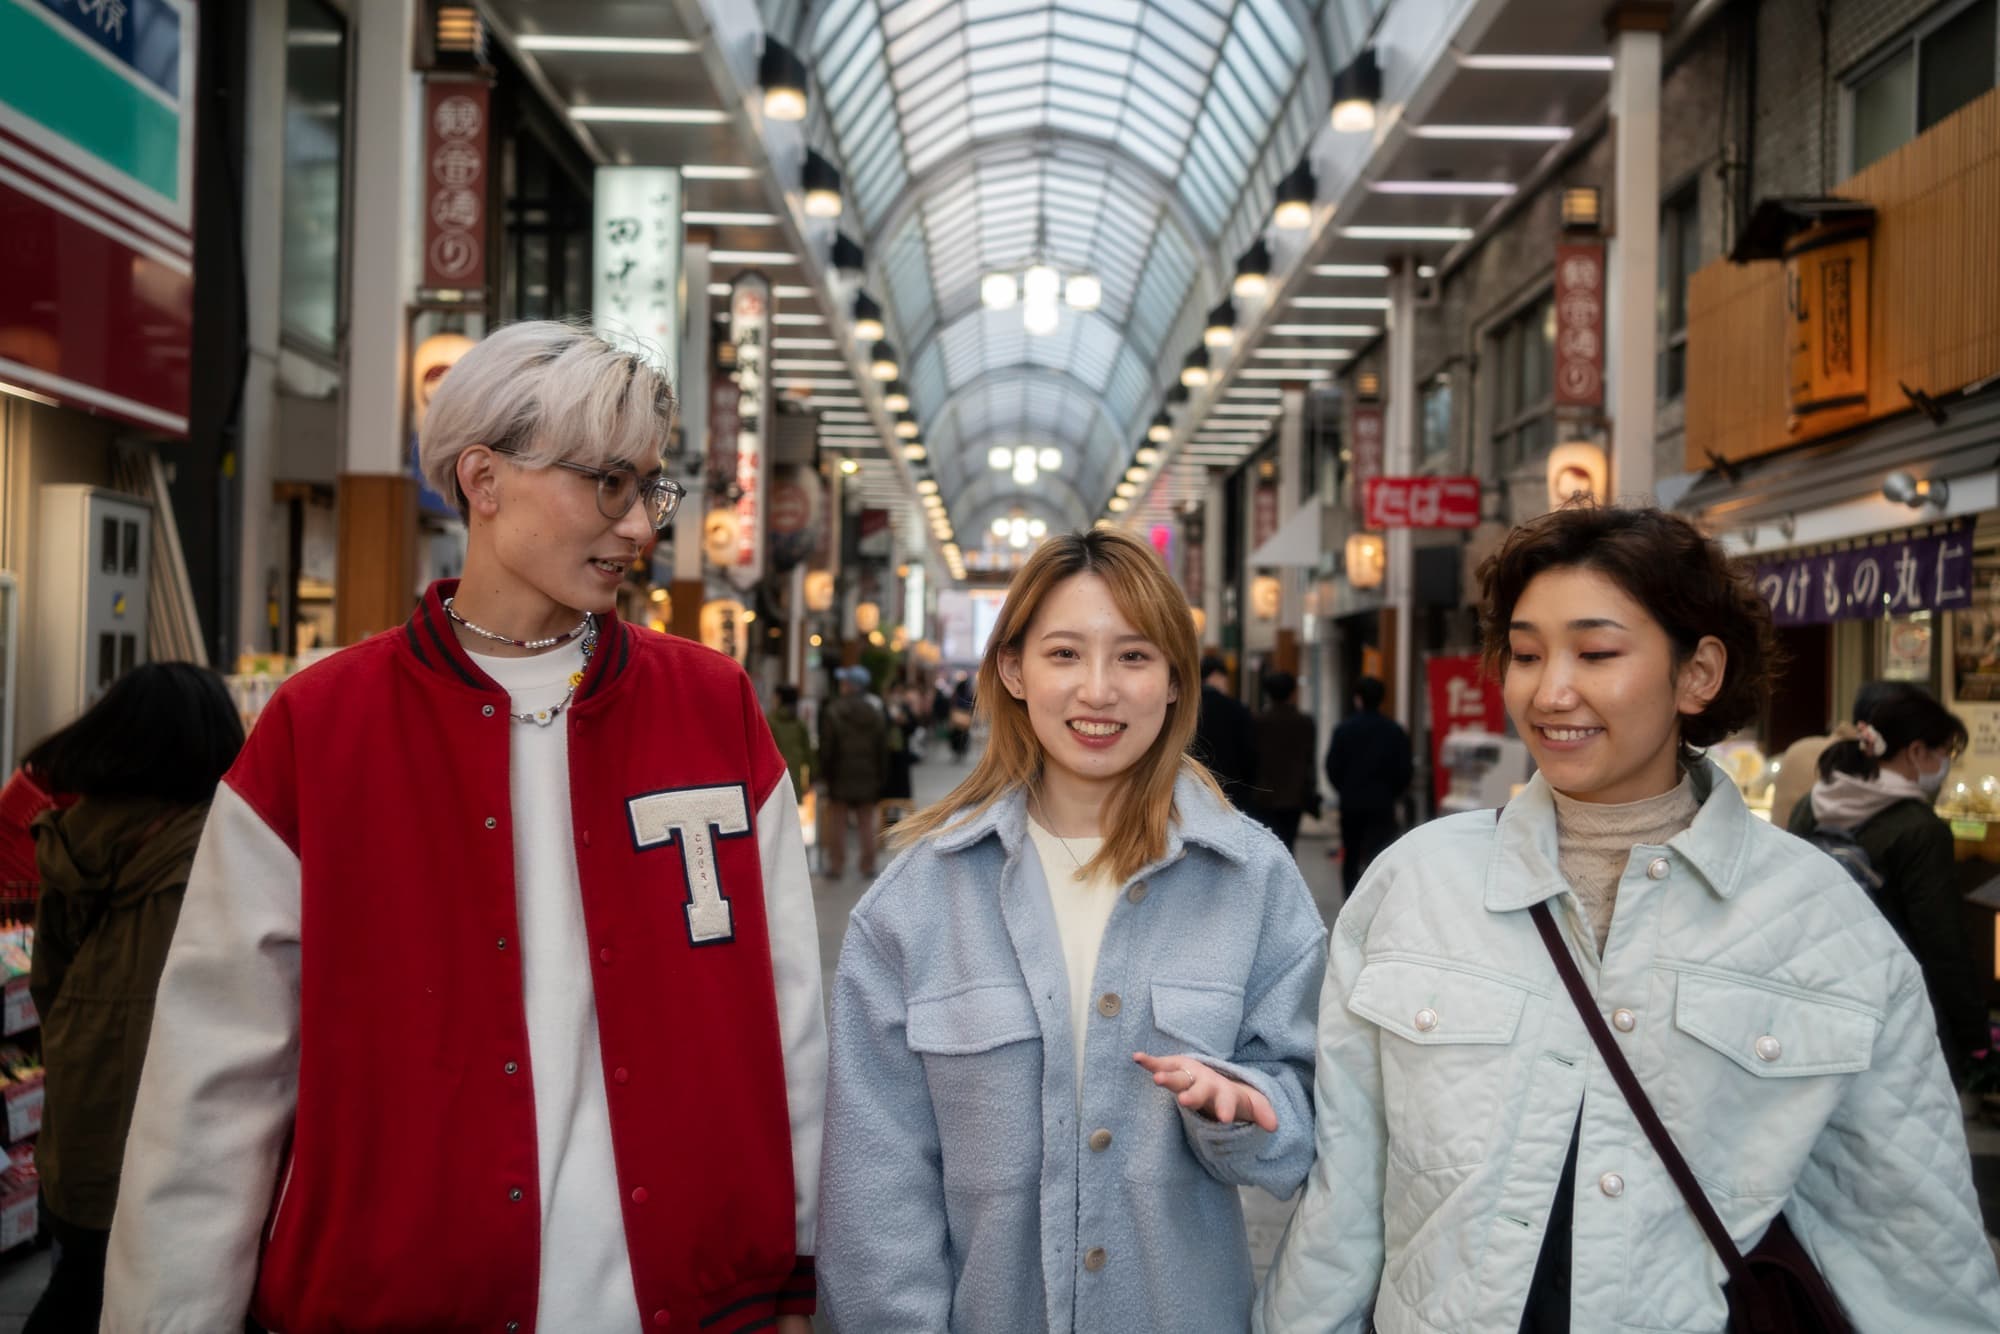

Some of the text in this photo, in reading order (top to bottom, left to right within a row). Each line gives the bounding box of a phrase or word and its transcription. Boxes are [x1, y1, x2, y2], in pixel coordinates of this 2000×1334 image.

[429, 96, 483, 279] 観音通り
[1372, 482, 1477, 524] たばこ
[627, 784, 751, 946] T
